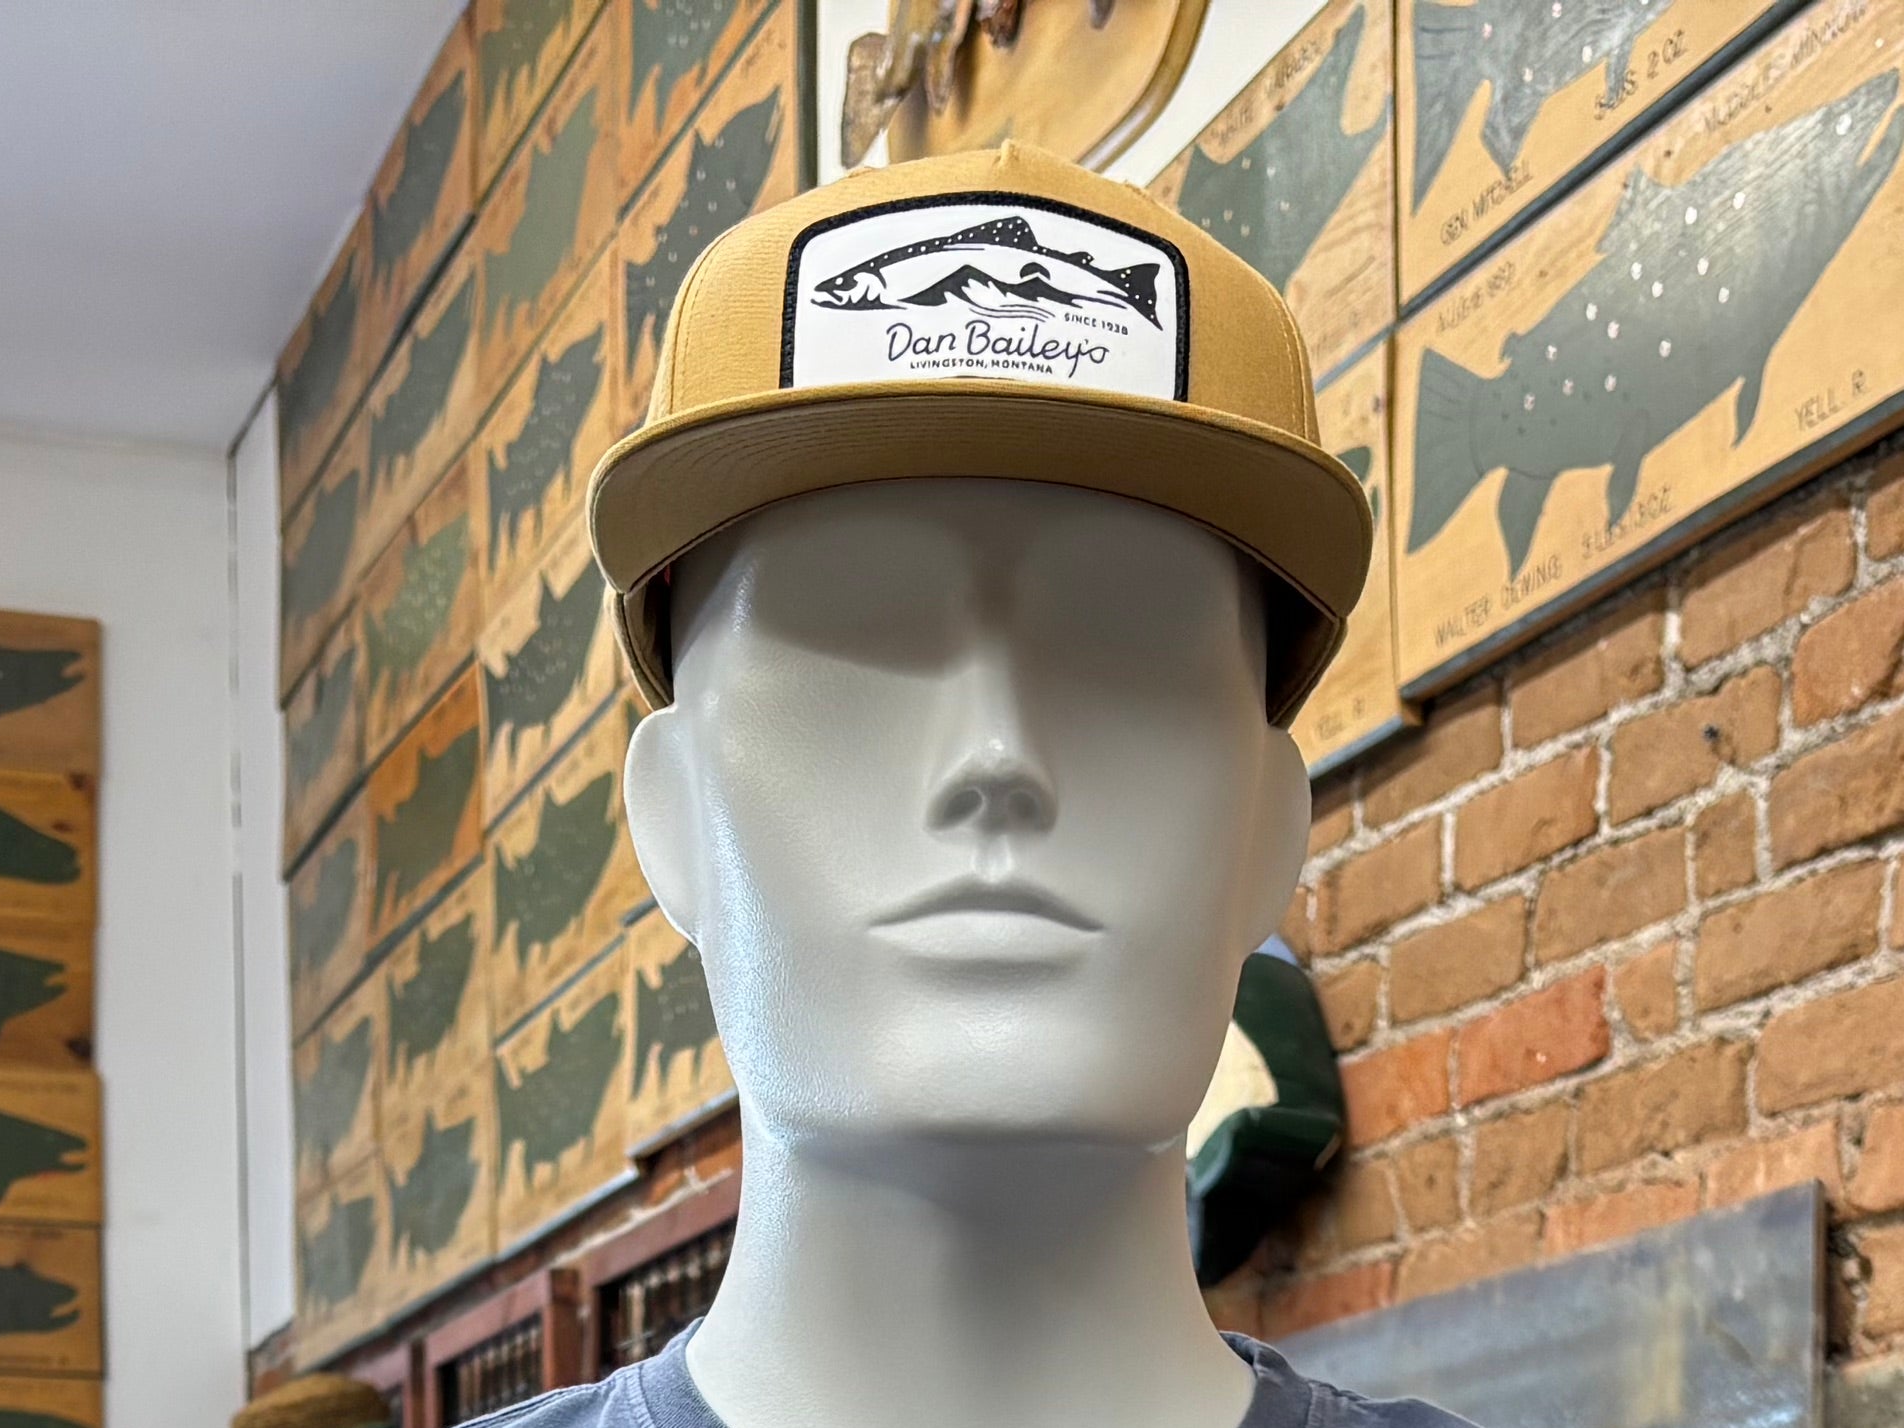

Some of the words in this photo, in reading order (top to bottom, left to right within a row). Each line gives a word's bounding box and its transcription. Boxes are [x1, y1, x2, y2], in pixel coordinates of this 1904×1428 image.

[1064, 312, 1097, 328] SINCE
[886, 322, 957, 362] Dan
[965, 319, 1110, 379] Bailey's
[910, 358, 989, 370] LIVINGSTON,
[990, 358, 1054, 375] MONTANA
